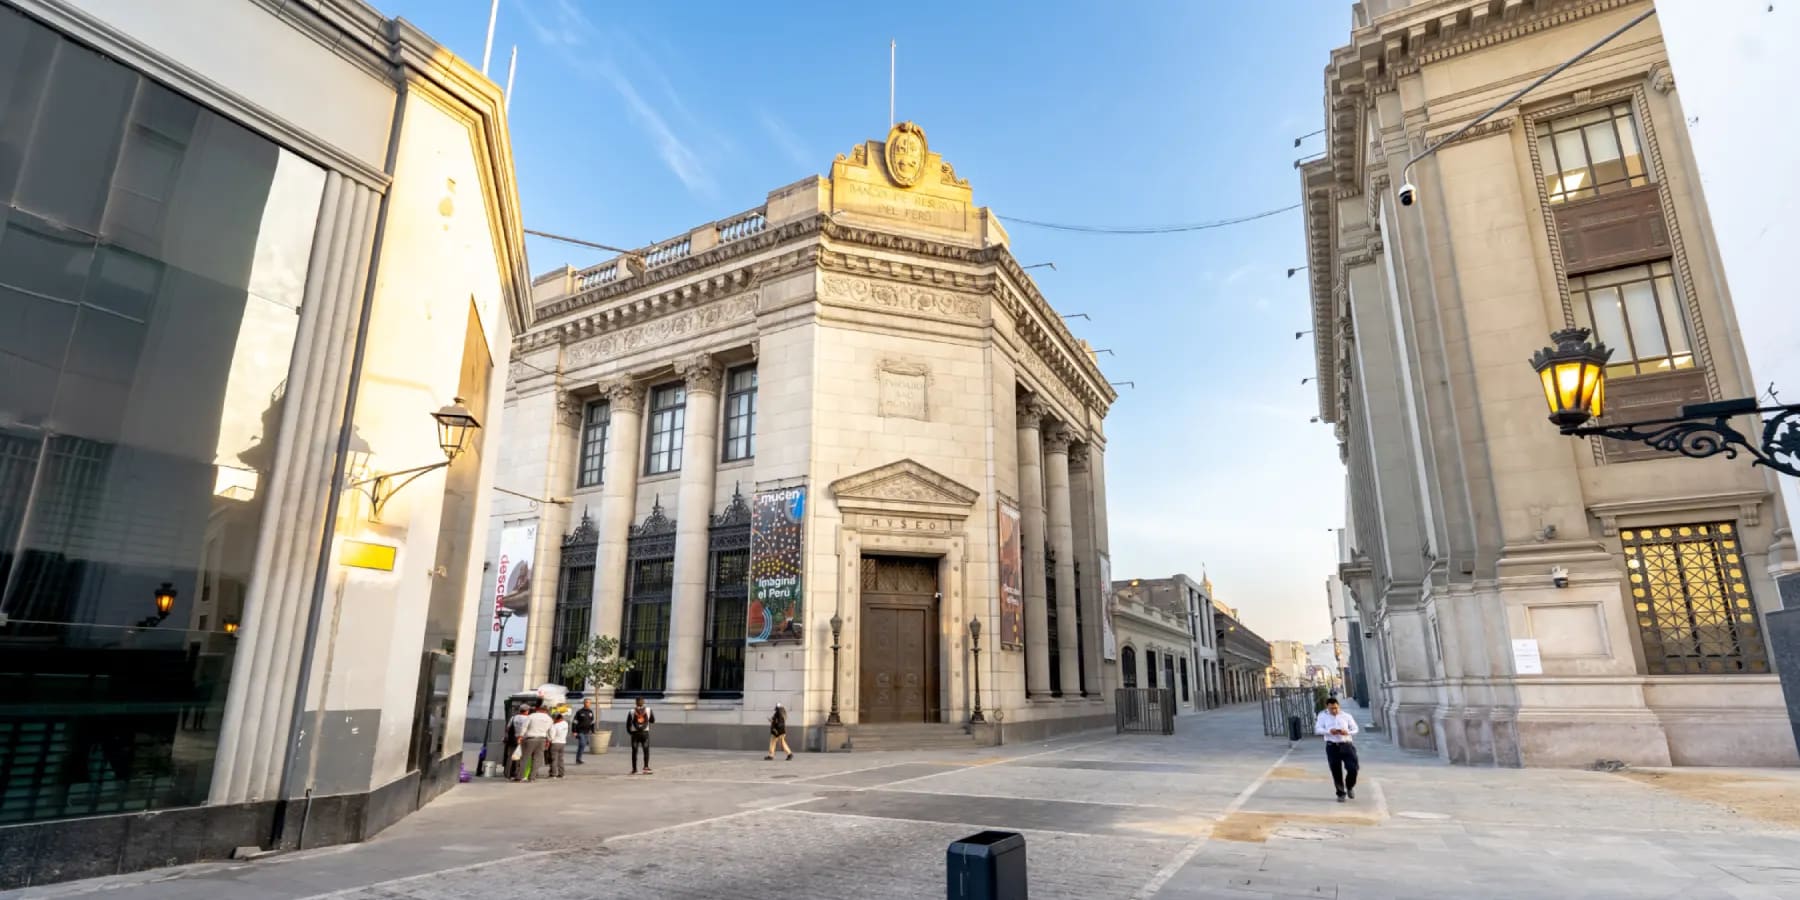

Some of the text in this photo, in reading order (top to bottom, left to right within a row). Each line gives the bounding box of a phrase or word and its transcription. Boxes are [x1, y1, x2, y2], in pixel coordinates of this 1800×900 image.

[761, 490, 800, 503] mucen
[872, 518, 936, 529] MVSEO
[758, 589, 767, 599] el
